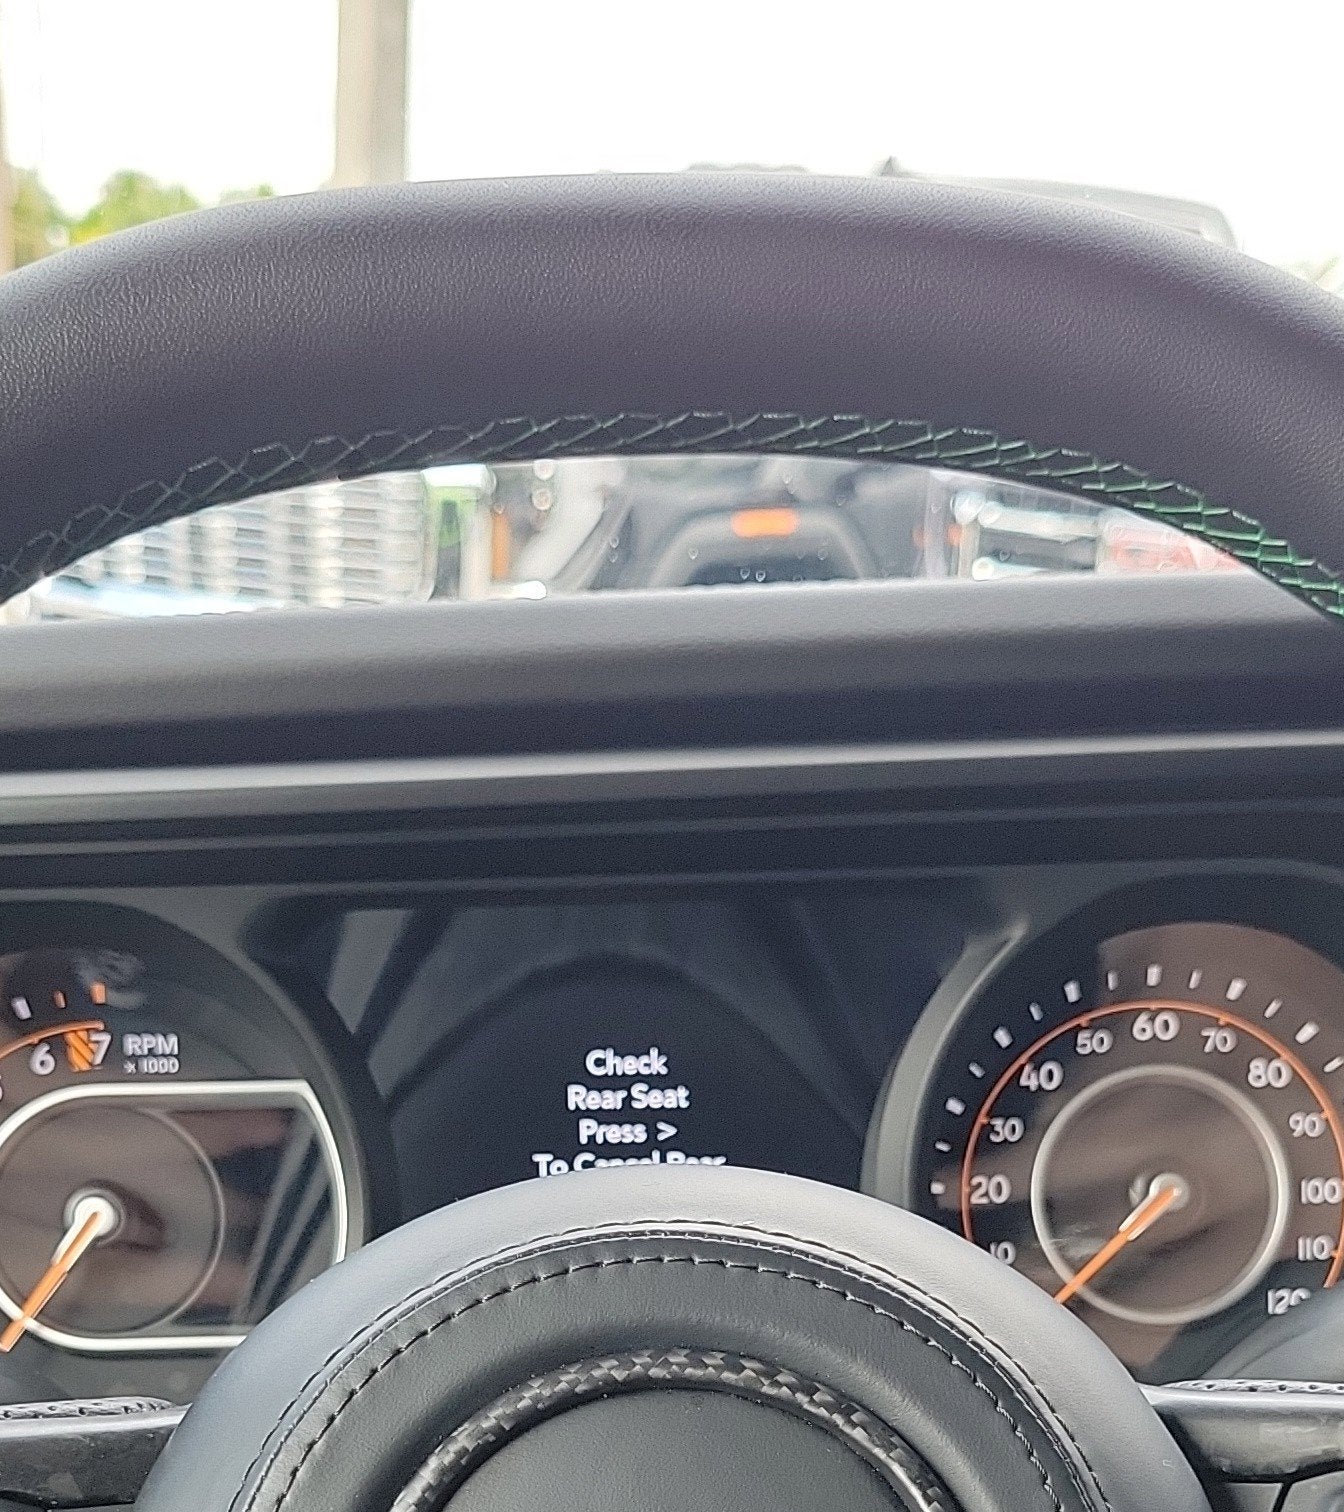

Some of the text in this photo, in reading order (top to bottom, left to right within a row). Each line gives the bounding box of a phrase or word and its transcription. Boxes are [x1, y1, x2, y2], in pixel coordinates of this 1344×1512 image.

[1132, 1010, 1180, 1041] 60
[1200, 1026, 1238, 1053] 70
[89, 1031, 111, 1065] 7
[122, 1033, 180, 1056] RPM
[1075, 1028, 1113, 1055] 50
[30, 1043, 55, 1075] 6
[138, 1056, 181, 1074] 1000
[585, 1047, 668, 1077] Check
[1247, 1057, 1293, 1089] 80
[1019, 1060, 1064, 1092] 40
[567, 1082, 690, 1111] Rear Seat
[579, 1118, 647, 1146] Press
[989, 1116, 1025, 1143] 30
[1289, 1111, 1325, 1138] 90
[531, 1153, 569, 1178] To
[970, 1174, 1011, 1205] 20
[1300, 1176, 1344, 1204] 100
[989, 1241, 1017, 1265] 10
[1297, 1234, 1335, 1261] 110
